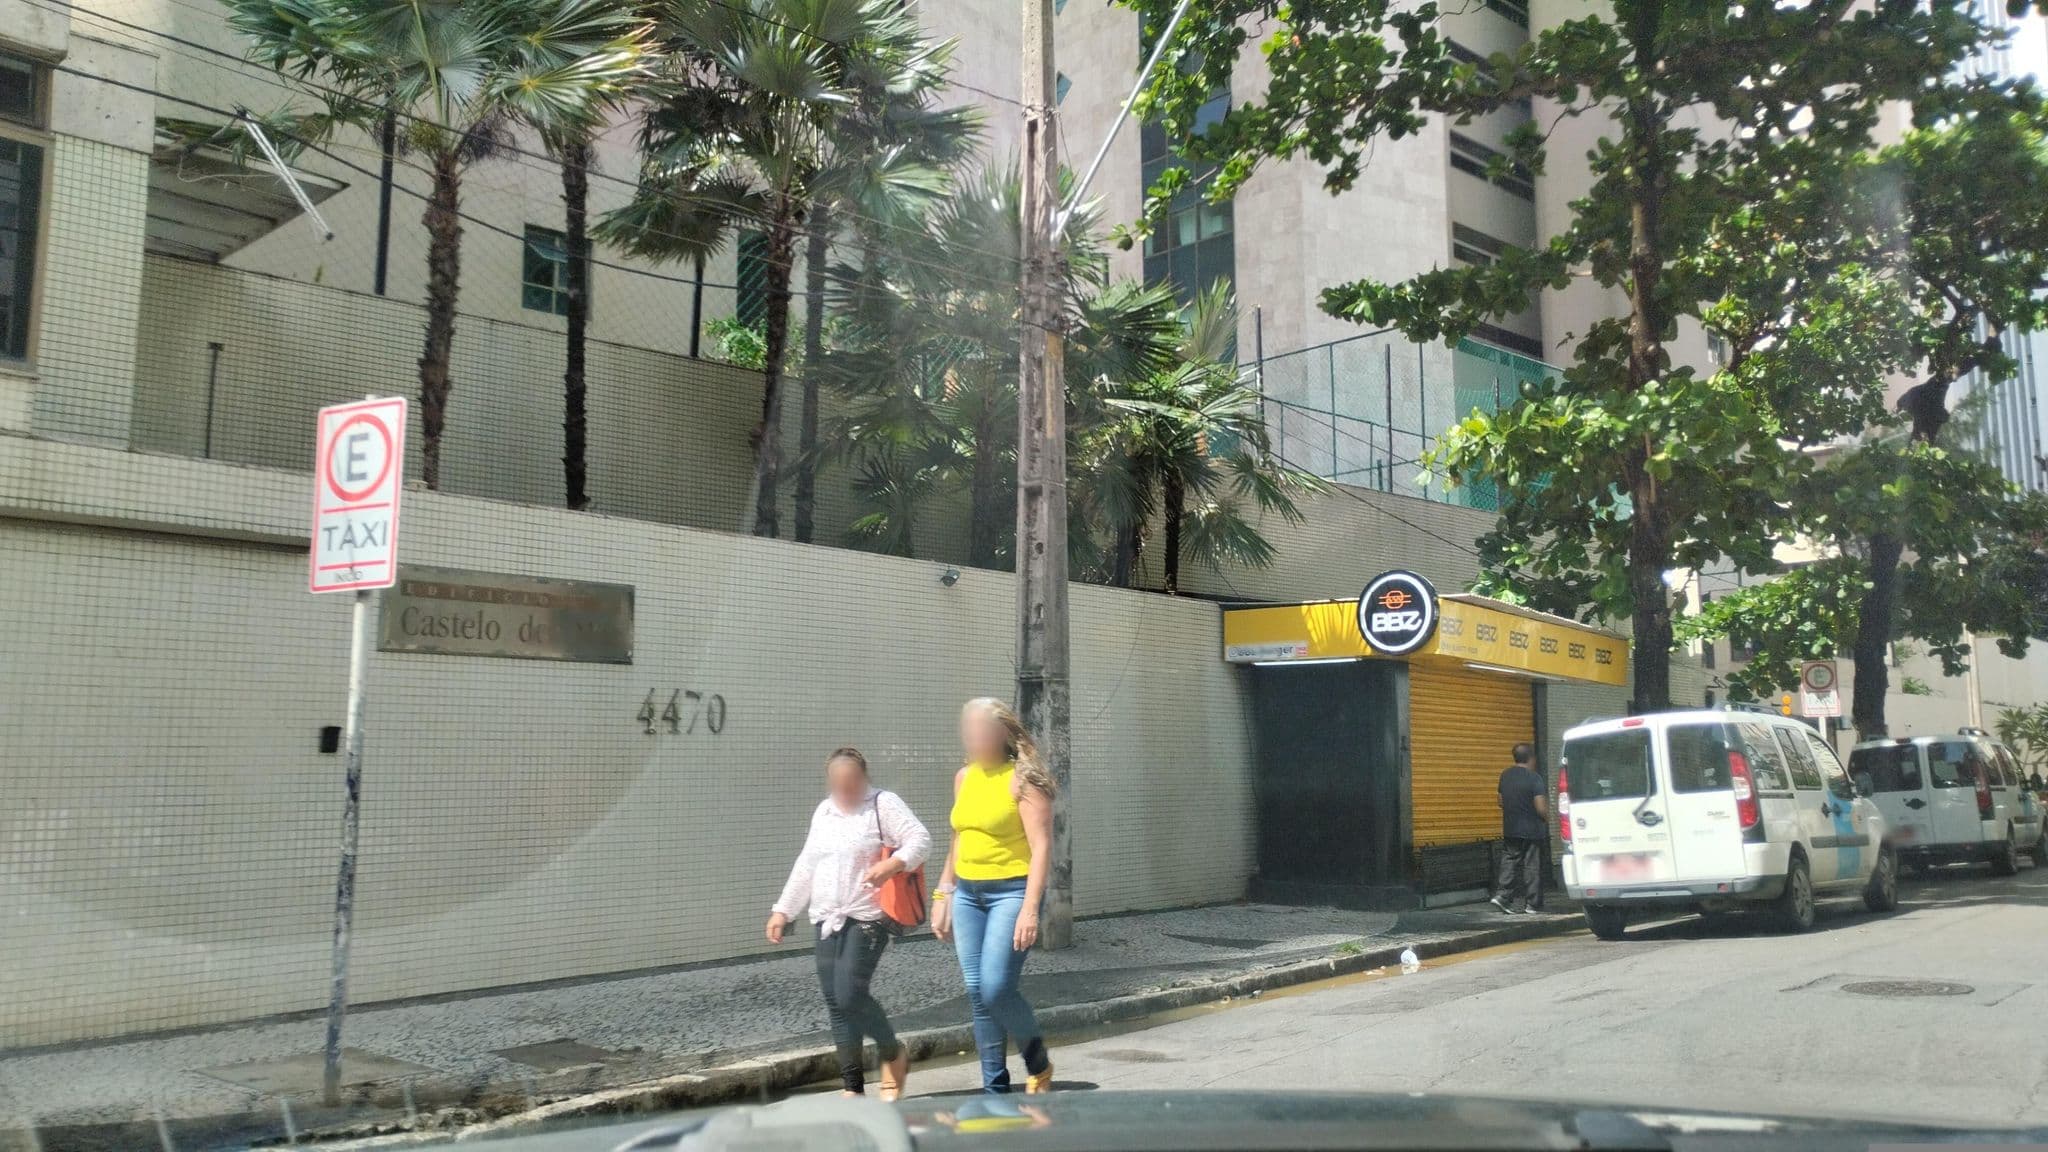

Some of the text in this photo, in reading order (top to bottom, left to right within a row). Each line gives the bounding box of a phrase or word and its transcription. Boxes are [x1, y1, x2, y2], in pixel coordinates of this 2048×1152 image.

[346, 432, 370, 482] E
[401, 605, 501, 641] Castelo
[1371, 610, 1423, 632] BBZ
[1475, 623, 1497, 642] BBZ
[1509, 630, 1530, 649] BBZ
[1539, 636, 1559, 654] BBZ
[1568, 642, 1586, 659] BBZ
[1595, 647, 1613, 665] BBZ
[636, 687, 727, 735] 4470
